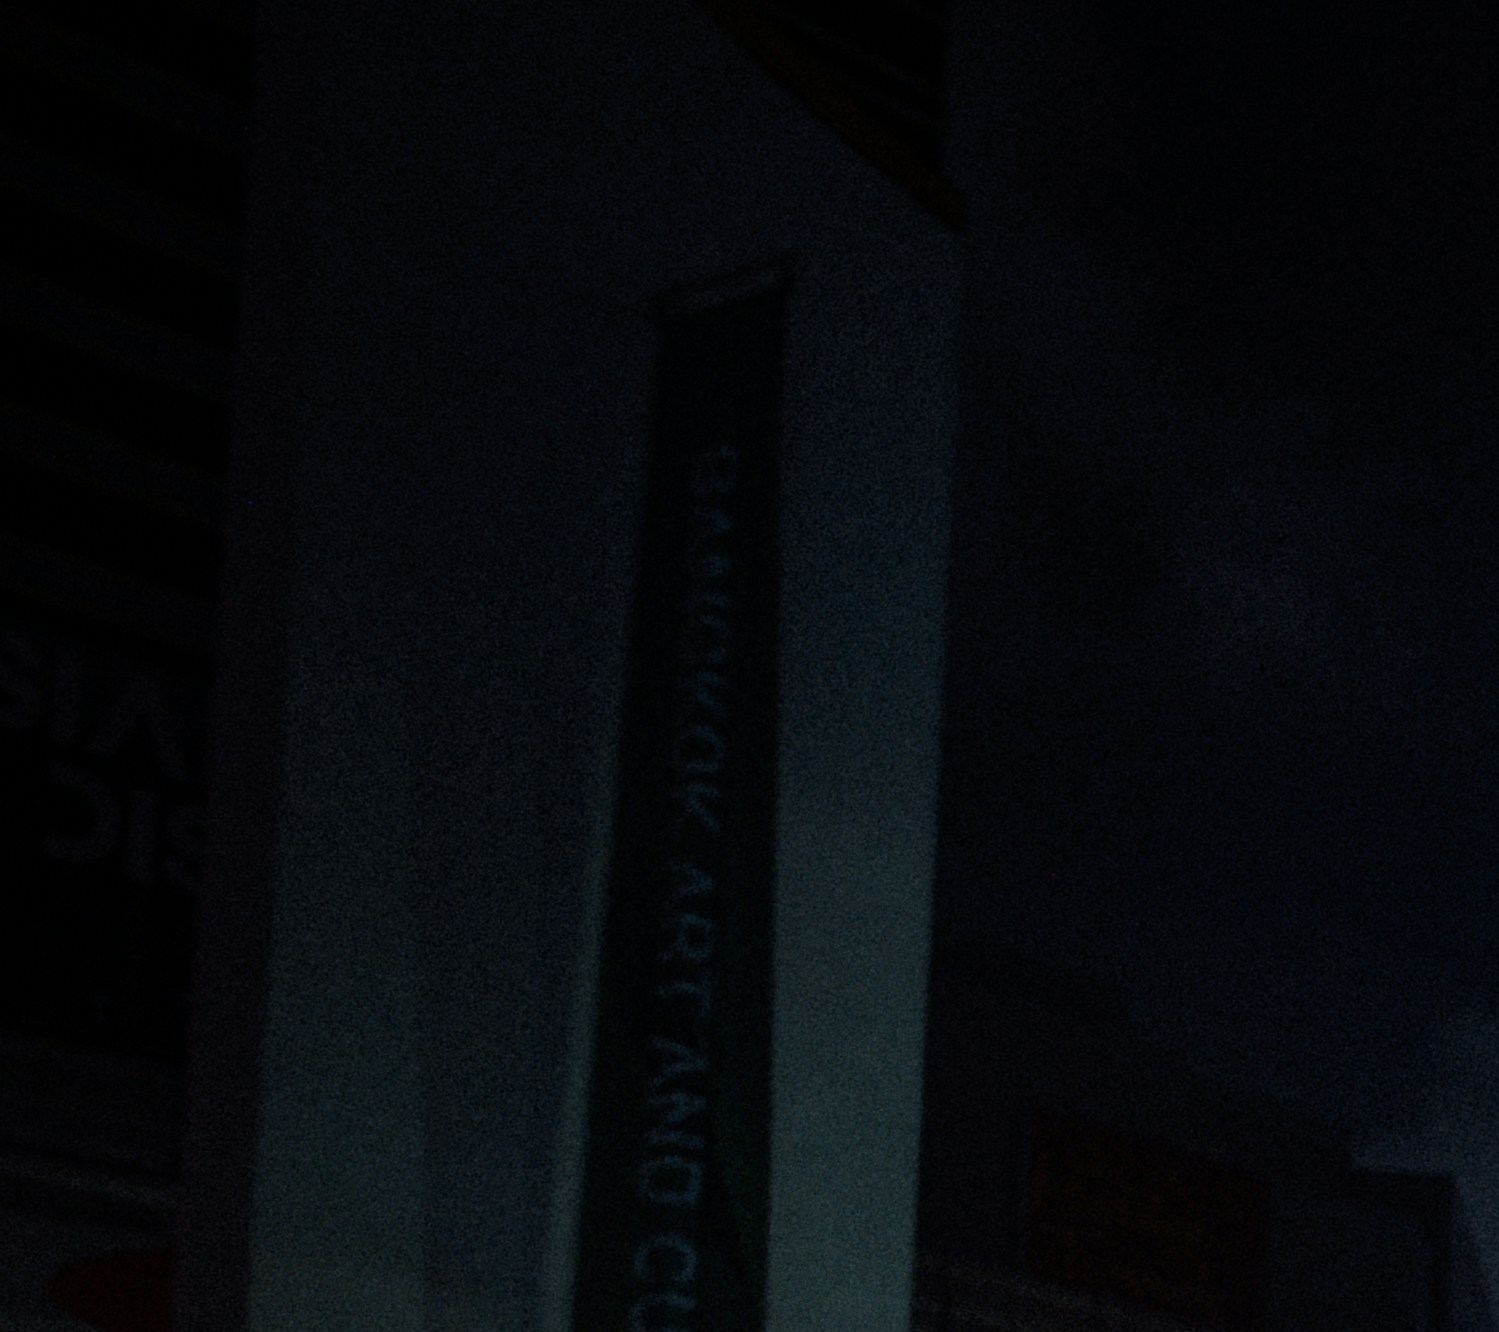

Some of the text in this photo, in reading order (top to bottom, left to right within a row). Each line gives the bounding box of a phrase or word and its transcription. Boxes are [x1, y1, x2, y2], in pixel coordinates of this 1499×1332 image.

[672, 443, 740, 837] BANGKOK
[652, 858, 720, 1018] ART
[636, 1036, 709, 1207] AND
